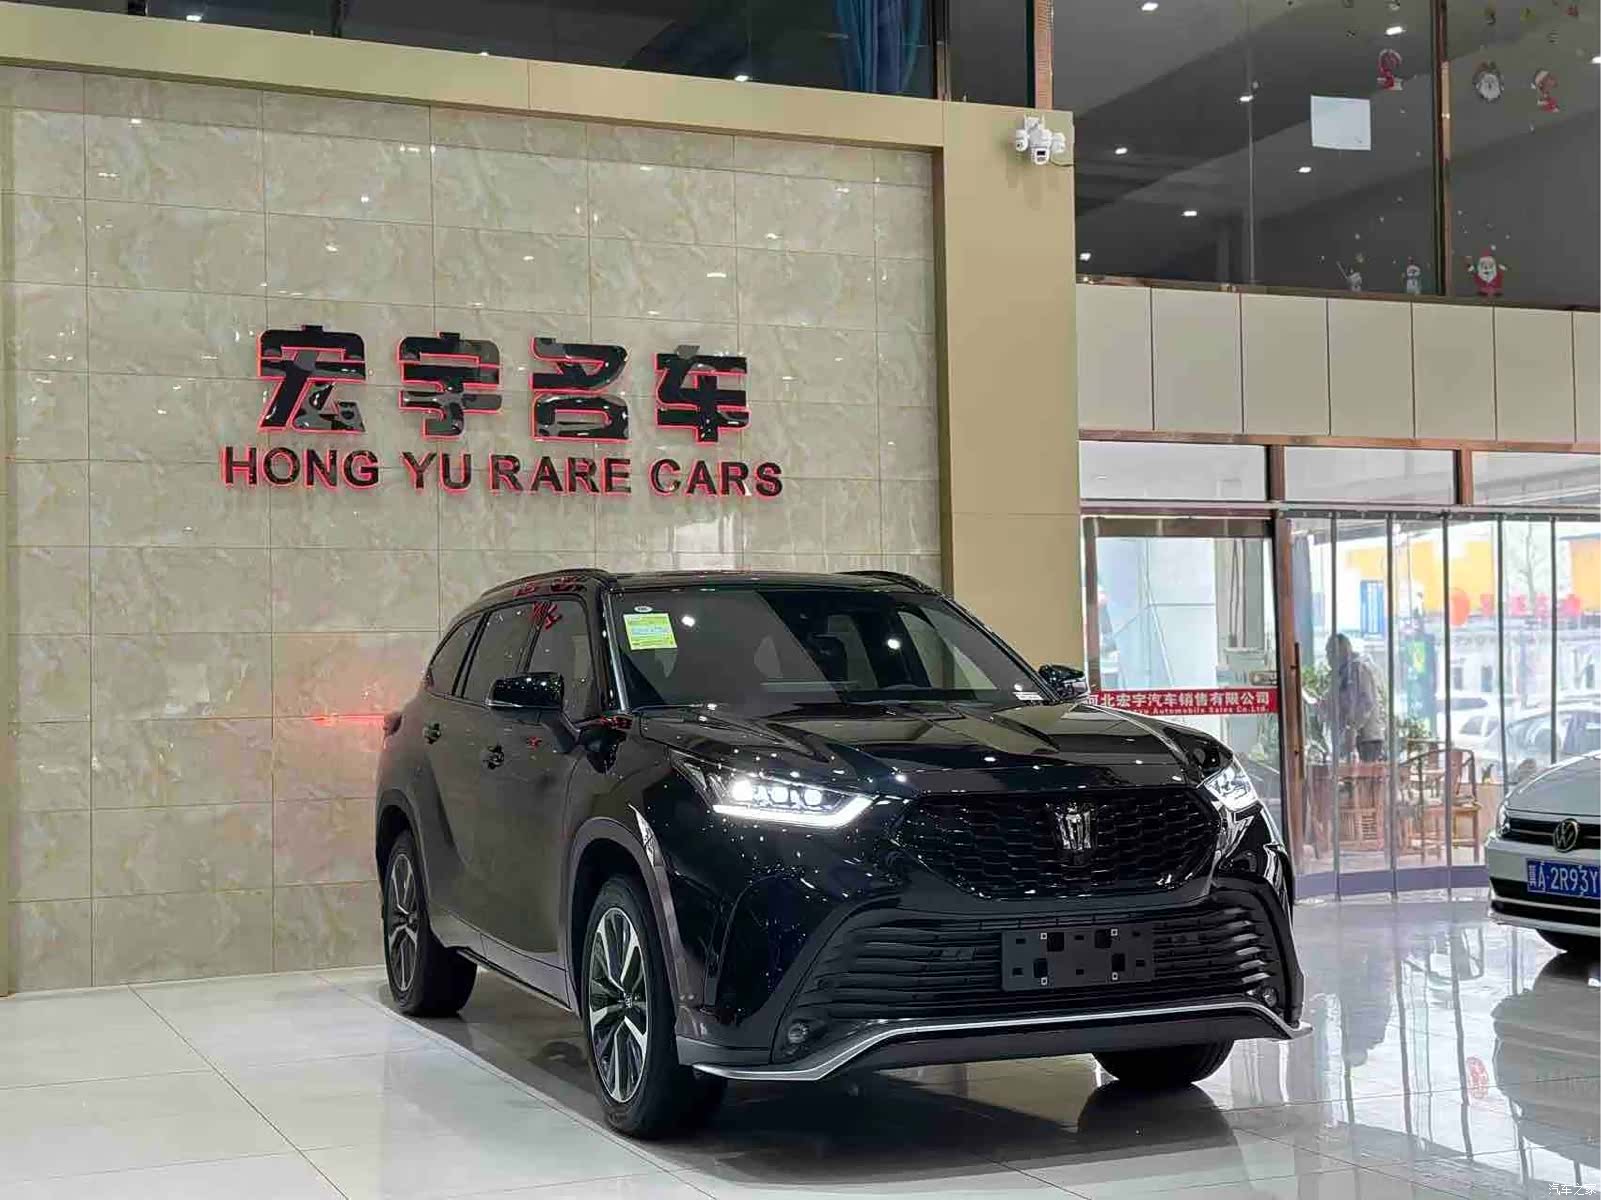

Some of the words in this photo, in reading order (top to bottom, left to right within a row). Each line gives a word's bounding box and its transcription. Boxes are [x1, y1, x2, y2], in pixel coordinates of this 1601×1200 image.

[257, 324, 750, 443] 宏宇名车
[221, 446, 380, 489] HONG
[401, 450, 473, 492] YU
[489, 454, 633, 496] RARE
[649, 458, 784, 497] CARS
